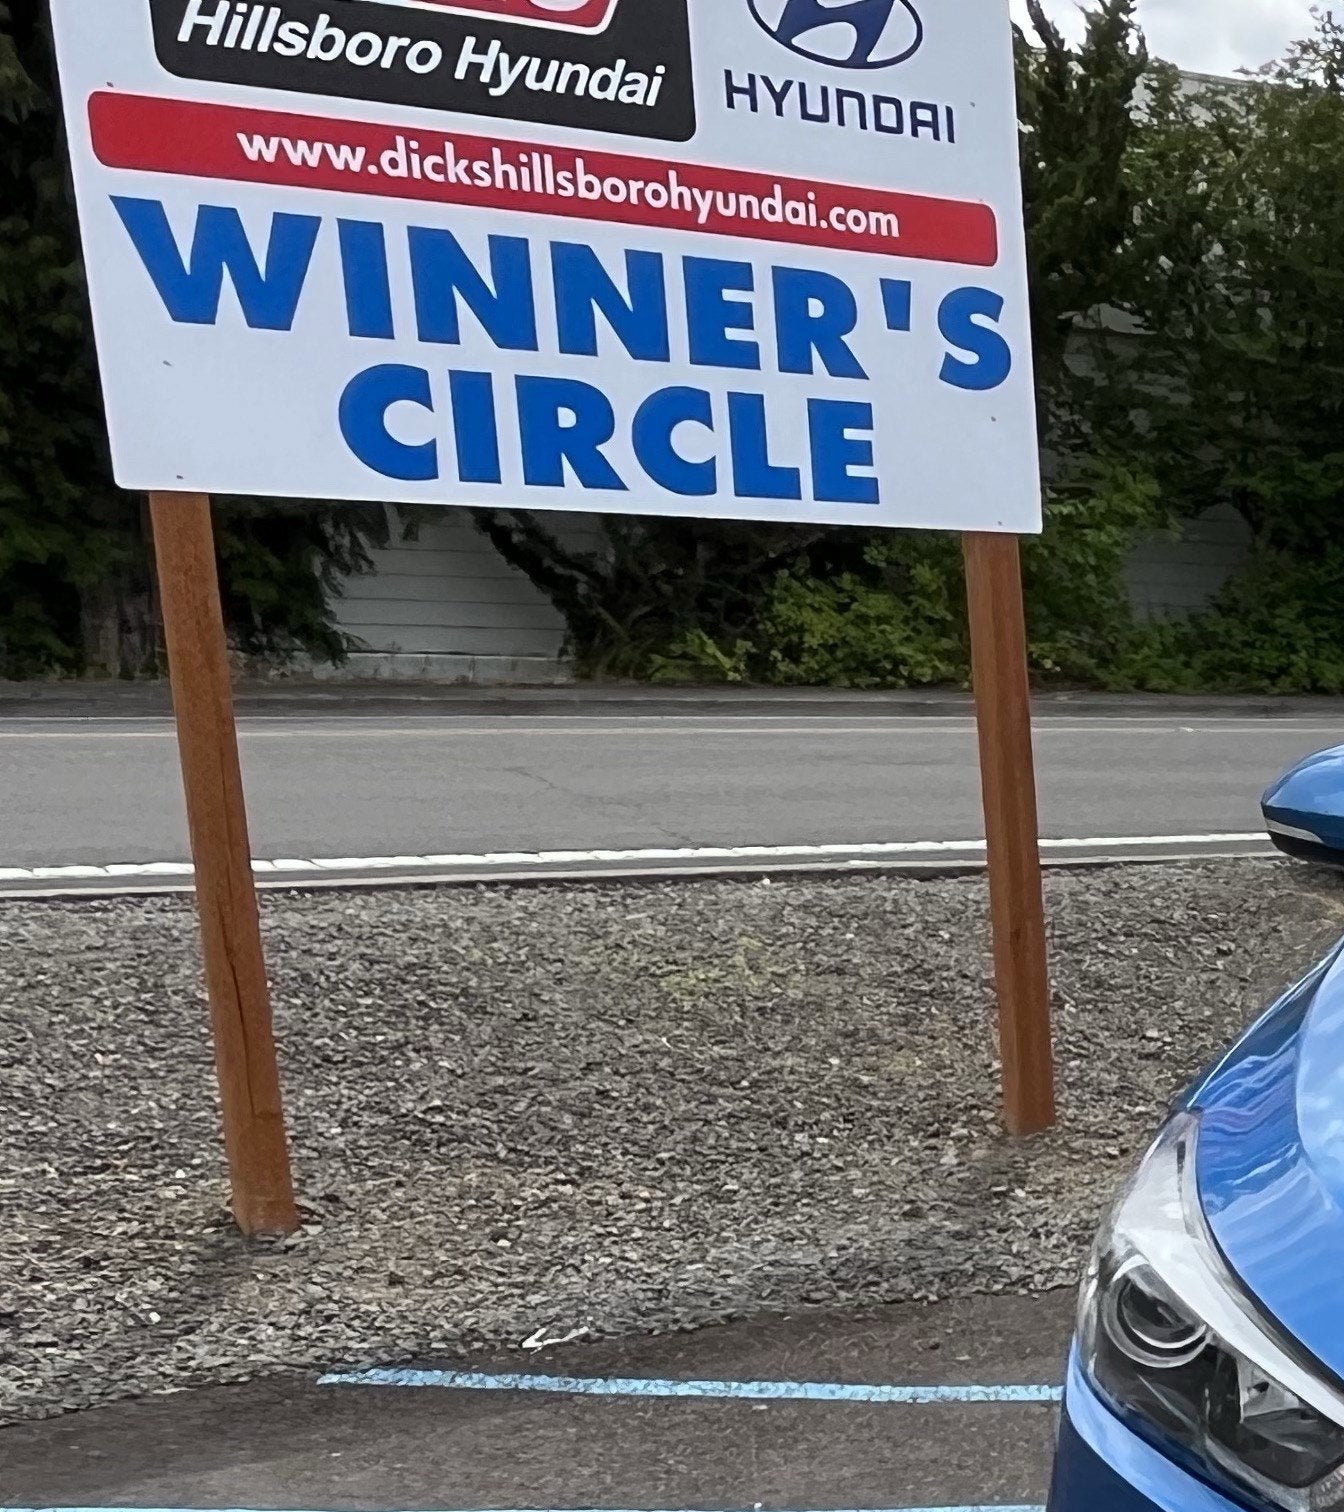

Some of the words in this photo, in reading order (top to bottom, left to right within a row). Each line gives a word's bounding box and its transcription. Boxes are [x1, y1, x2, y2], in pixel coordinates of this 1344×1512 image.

[177, 0, 442, 74] Hillsboro
[453, 36, 666, 107] Hyundai
[723, 69, 956, 144] HYUNDAI
[237, 131, 900, 239] www.dickshillsborohyundai.com
[109, 195, 1011, 391] WINNER'S
[338, 363, 881, 506] CIRCLE
